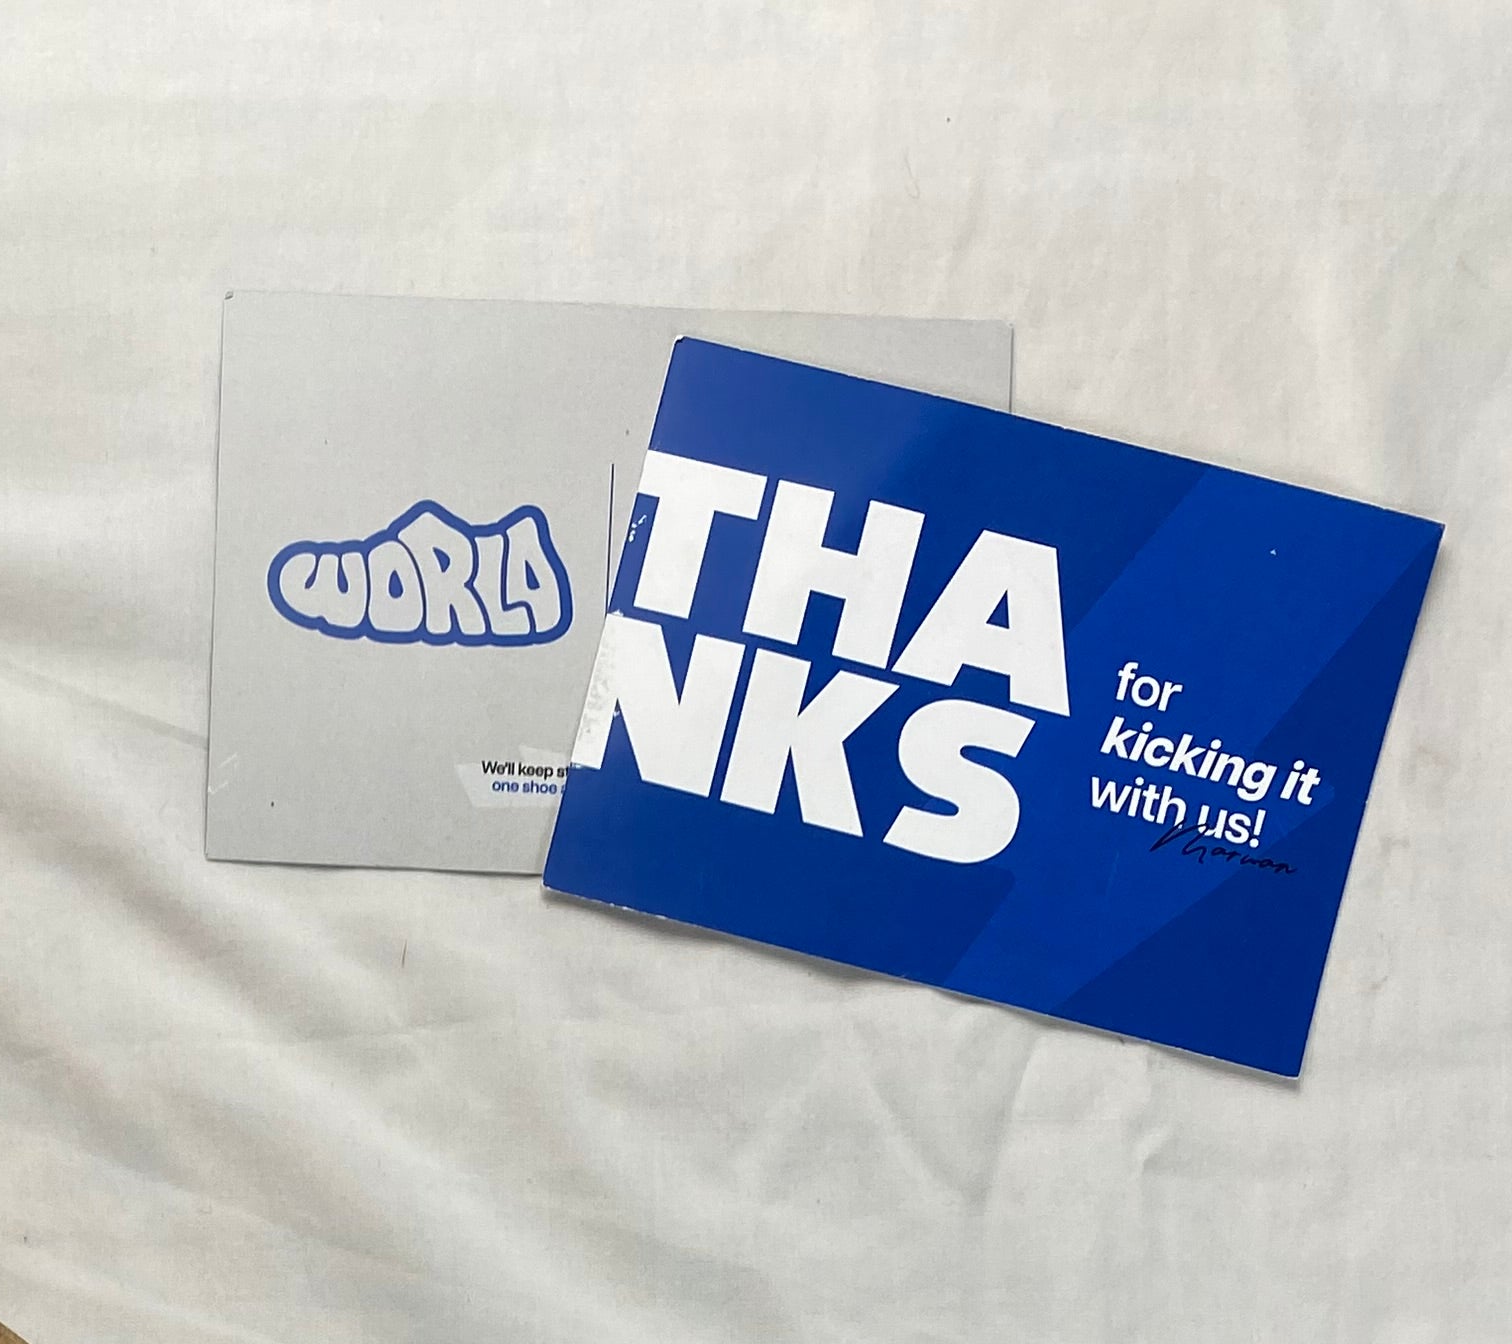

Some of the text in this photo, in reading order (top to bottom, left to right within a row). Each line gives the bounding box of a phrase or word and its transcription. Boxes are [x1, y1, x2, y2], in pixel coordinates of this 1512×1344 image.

[271, 503, 569, 642] WORLD
[633, 449, 1071, 717] THA
[1115, 661, 1183, 712] for
[481, 760, 515, 776] We'll
[518, 762, 554, 780] keep
[571, 613, 1037, 864] NKS
[1100, 715, 1321, 806] kicking it
[491, 781, 519, 792] one
[522, 780, 558, 795] shoe
[1091, 776, 1267, 848] with us!
